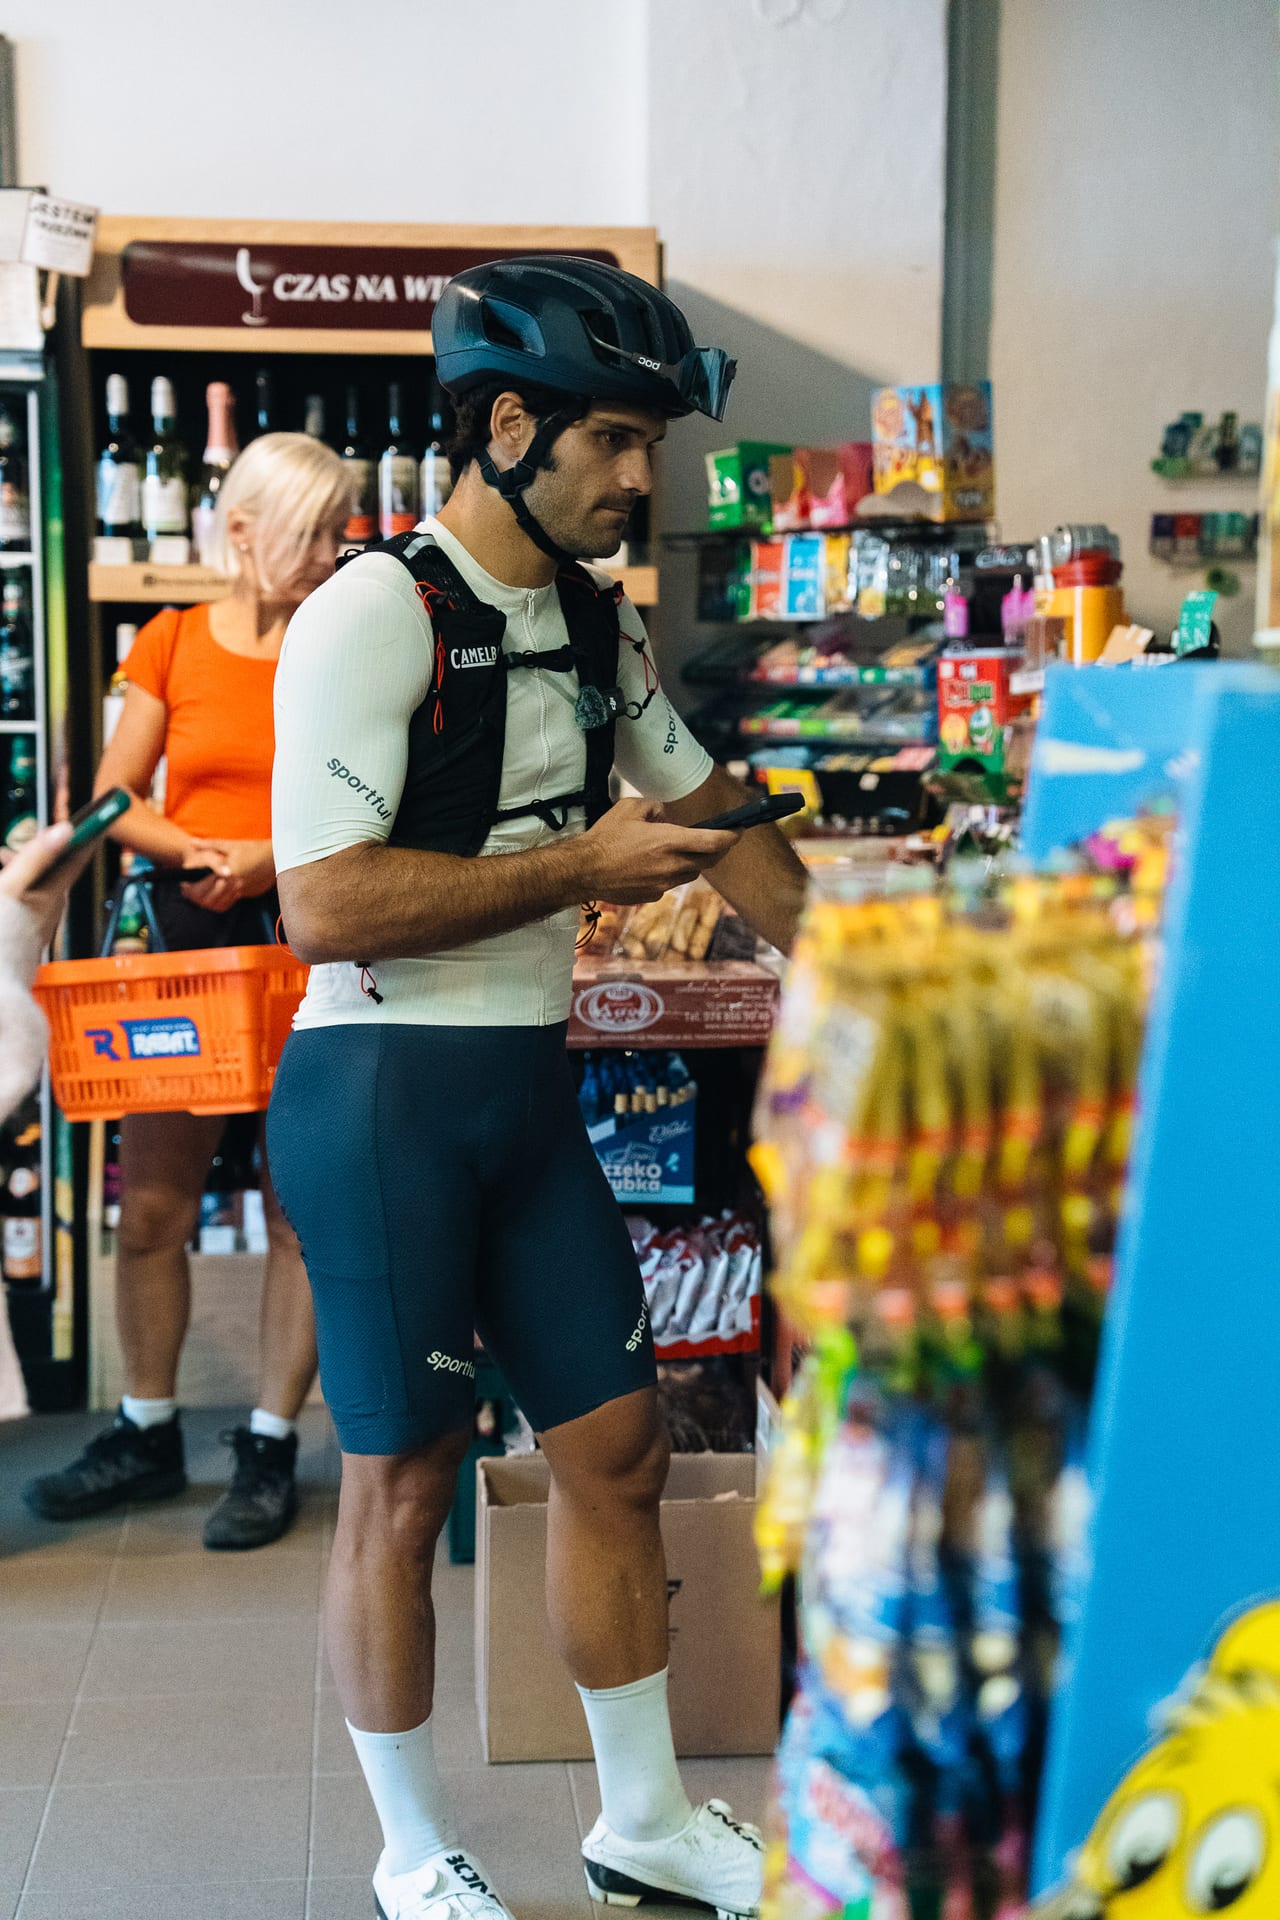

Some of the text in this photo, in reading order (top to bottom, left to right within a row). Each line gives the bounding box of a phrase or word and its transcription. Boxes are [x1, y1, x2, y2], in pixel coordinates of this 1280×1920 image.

[273, 273, 350, 301] CZAS
[353, 274, 398, 302] NA
[451, 646, 499, 669] CAMELB
[327, 758, 392, 820] sportful
